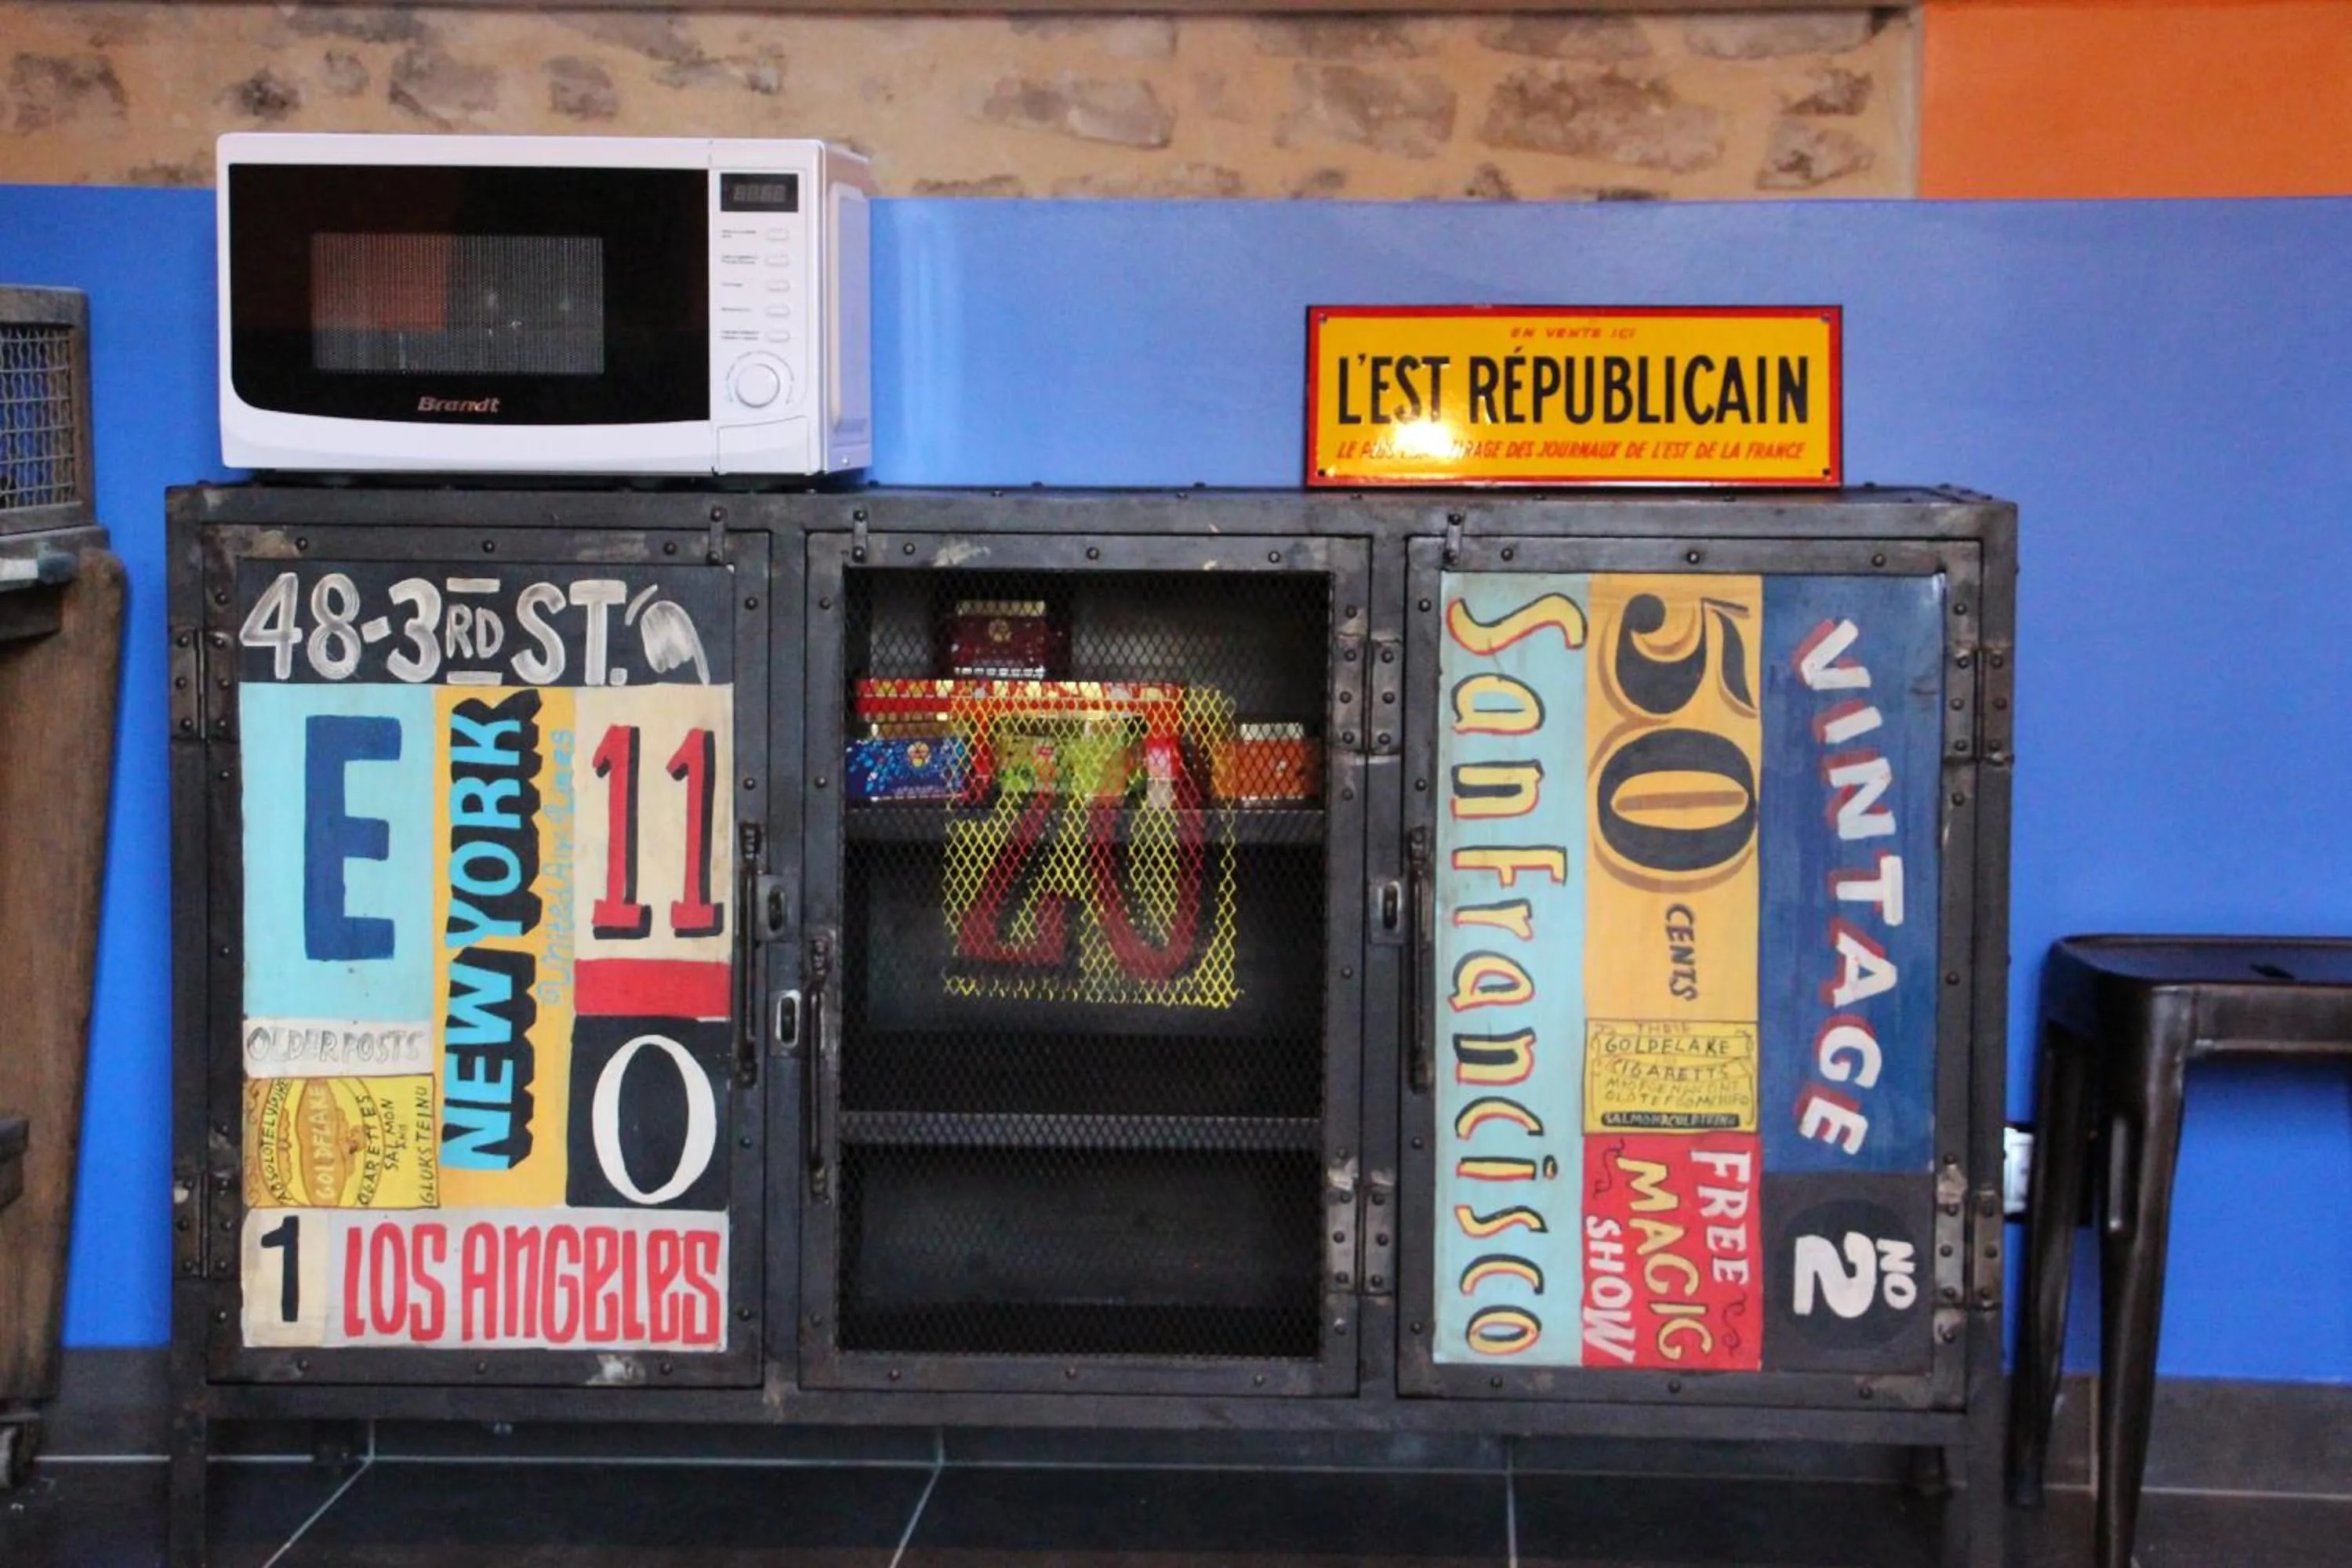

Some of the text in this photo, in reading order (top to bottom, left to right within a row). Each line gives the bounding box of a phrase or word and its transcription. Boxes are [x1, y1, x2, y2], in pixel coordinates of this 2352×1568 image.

[1338, 346, 1809, 426] L'EST RÉPUBLICAIN
[1511, 327, 1636, 339] EN VENTE ICI
[417, 396, 499, 413] Brandt
[1337, 441, 1356, 459] LE
[1505, 441, 1536, 459] DES
[1537, 441, 1621, 460] JOURNAUX
[1624, 441, 1649, 460] DE
[1650, 441, 1691, 460] L'EST
[1693, 441, 1719, 460] DE
[1719, 441, 1741, 460] LA
[1745, 441, 1806, 460] FRANCE
[1595, 593, 1759, 873] 50
[303, 714, 402, 961] E
[1794, 618, 1905, 1156] VINTAGE
[440, 710, 522, 1171] NEW YORK
[1663, 902, 1697, 1002] CENTS
[260, 1215, 300, 1323] 1
[1615, 1156, 1715, 1362] MAGIC
[1690, 1149, 1752, 1287] FREE
[1793, 1231, 1878, 1319] 2
[1581, 1215, 1637, 1364] SHOW
